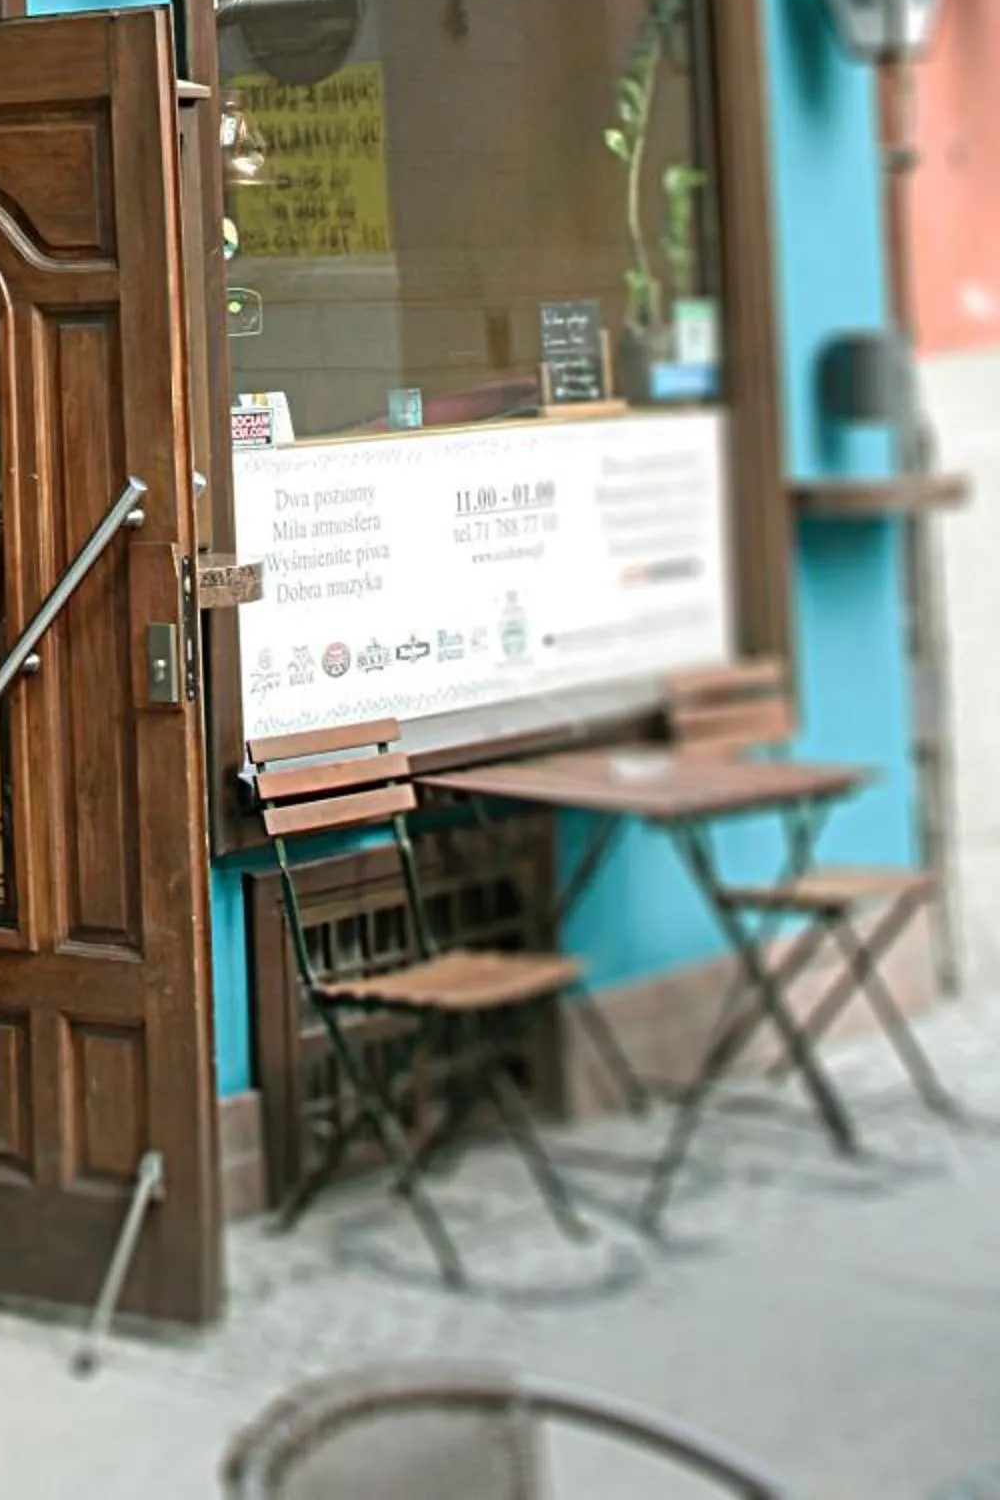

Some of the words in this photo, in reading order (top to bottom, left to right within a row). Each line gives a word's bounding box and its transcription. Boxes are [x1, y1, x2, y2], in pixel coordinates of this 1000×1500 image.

[274, 488, 310, 512] Dwa
[455, 486, 498, 513] 11.00
[310, 510, 382, 537] atmosfera
[355, 543, 391, 568] piwa
[276, 579, 322, 605] Dobra
[326, 570, 383, 600] muzyka
